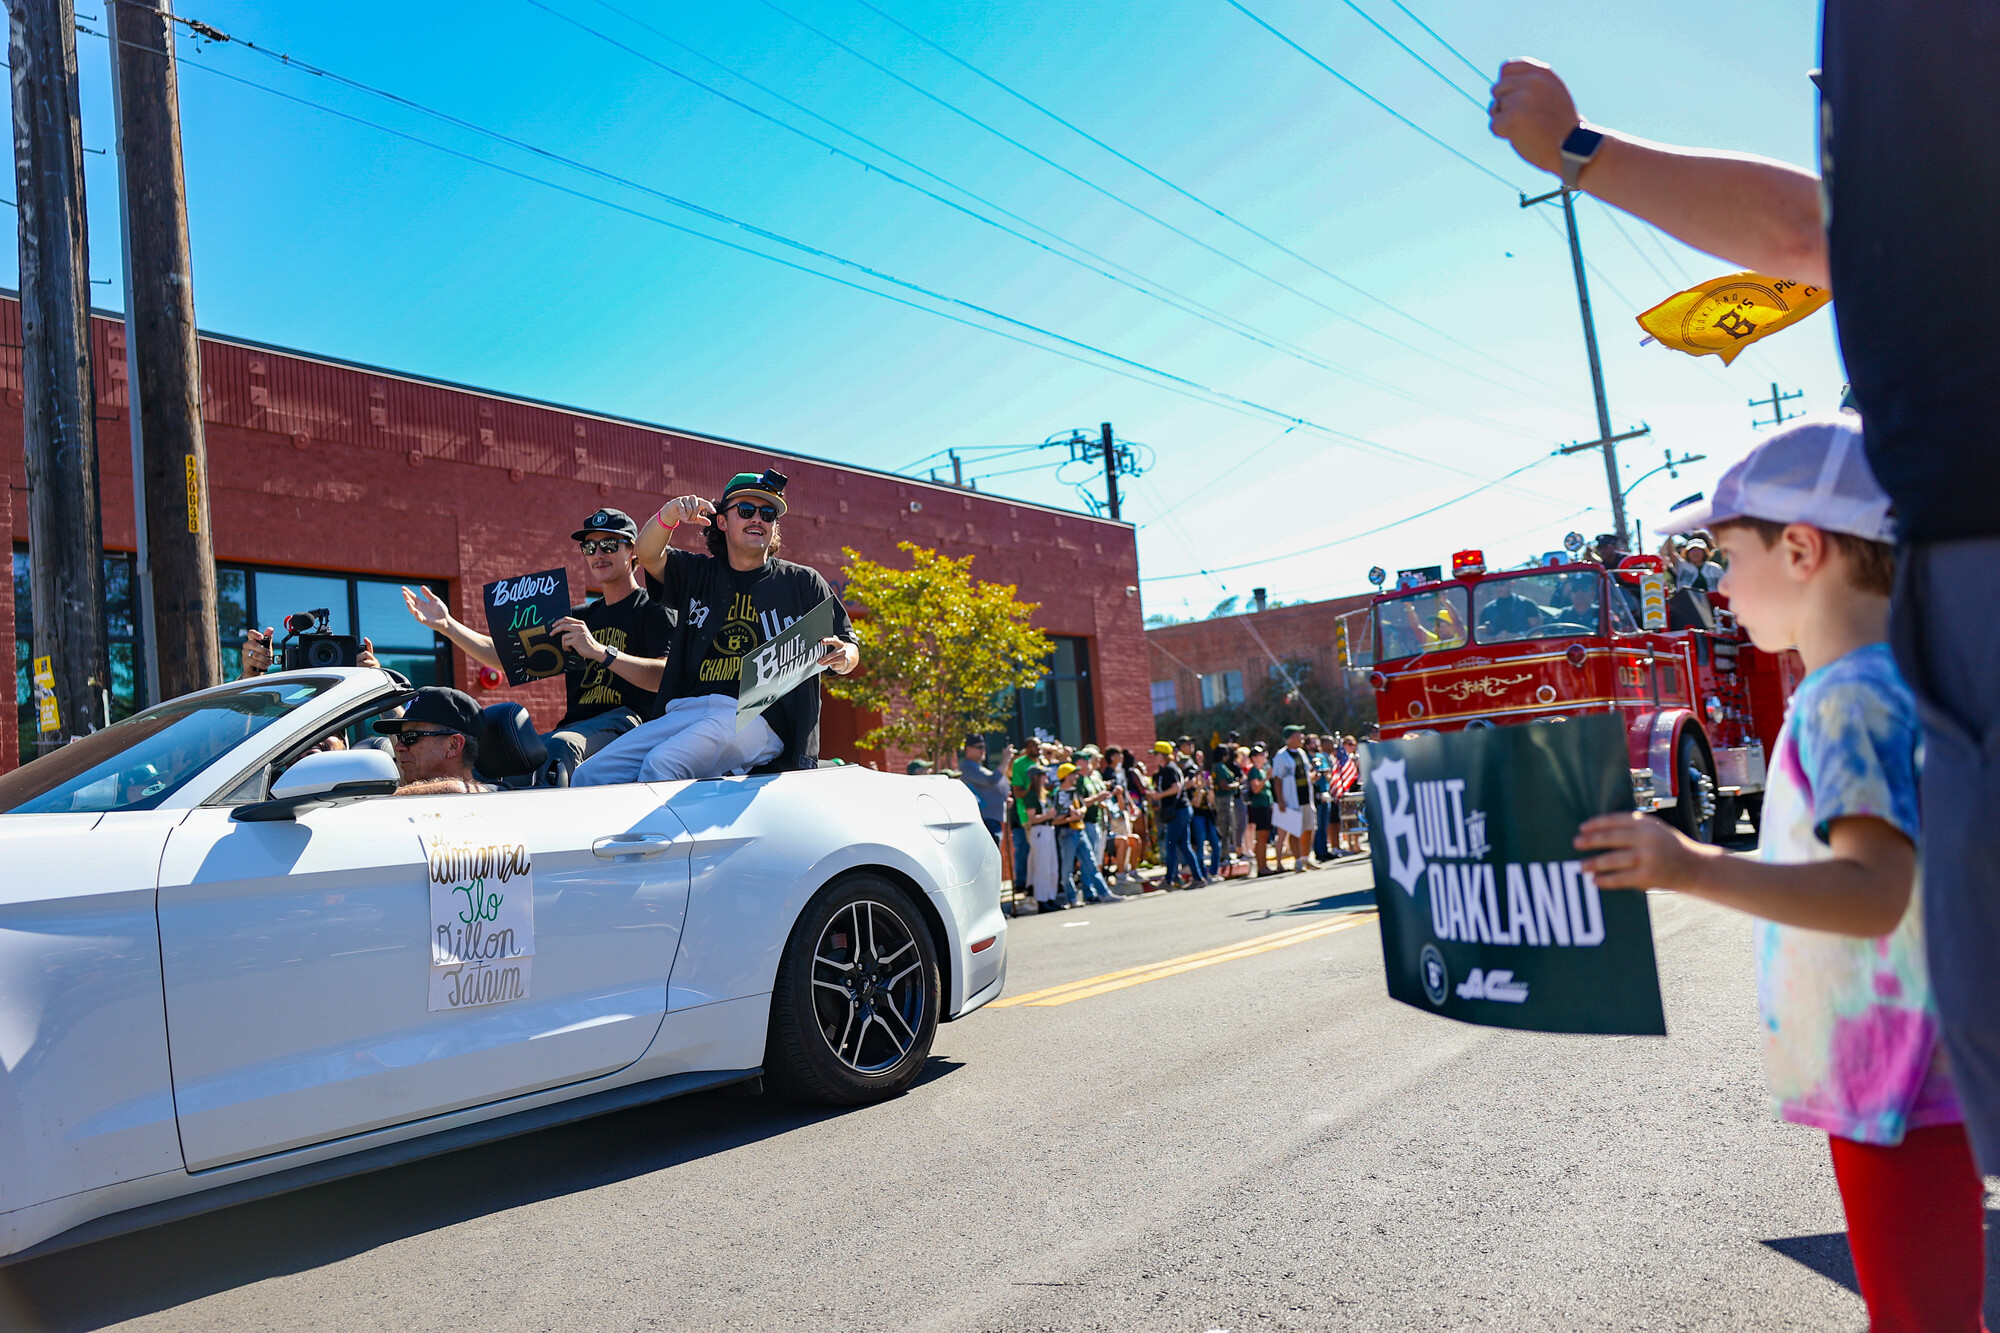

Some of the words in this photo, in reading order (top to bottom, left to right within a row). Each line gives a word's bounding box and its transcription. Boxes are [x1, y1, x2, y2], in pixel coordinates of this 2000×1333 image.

[491, 575, 560, 607] Ballers
[507, 605, 543, 632] in
[518, 624, 565, 678] 5
[1371, 757, 1467, 897] BUILT
[1427, 859, 1606, 947] OAKLAND
[436, 920, 521, 965] Dillon
